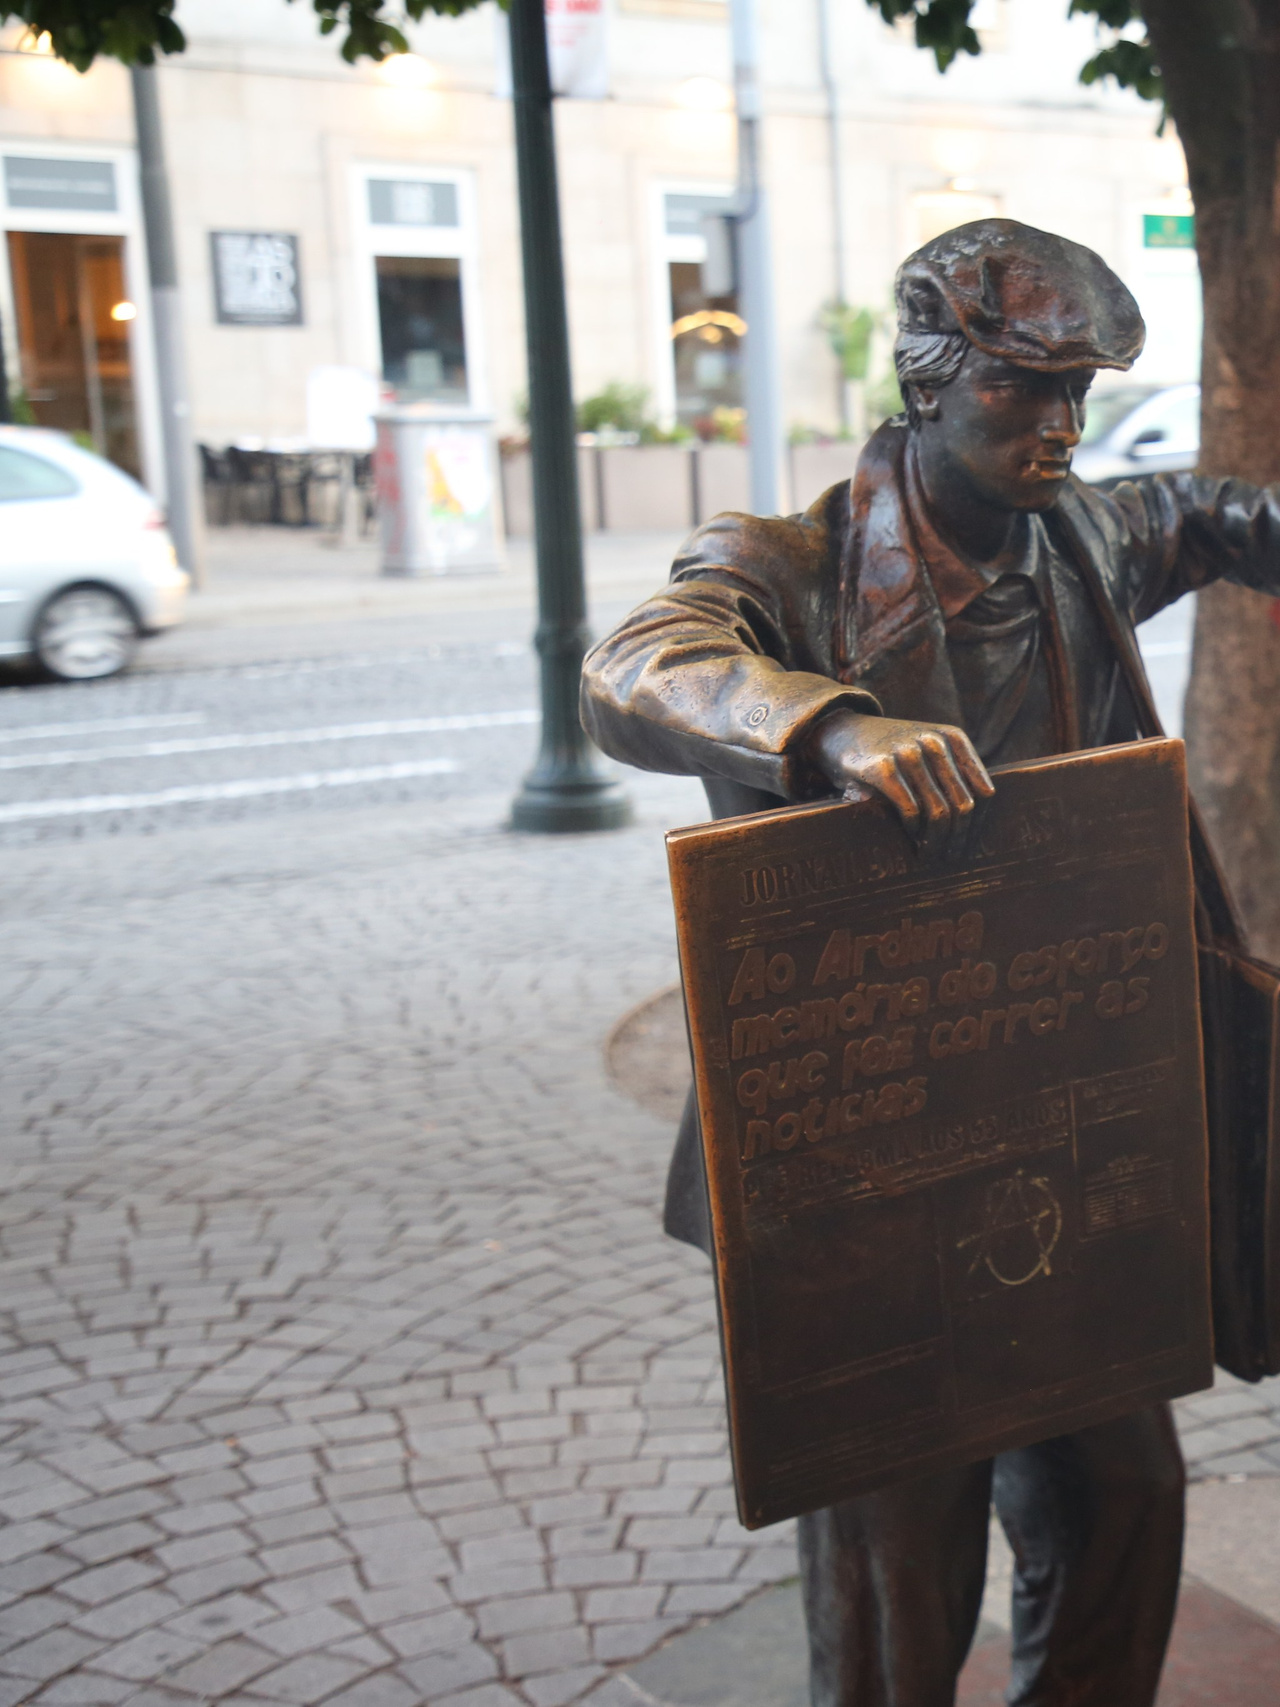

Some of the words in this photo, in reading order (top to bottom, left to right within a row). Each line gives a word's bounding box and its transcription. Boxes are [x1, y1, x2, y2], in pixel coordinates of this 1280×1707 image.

[727, 947, 797, 1006] Ao
[812, 910, 984, 986] Ardina
[732, 976, 930, 1060] memória
[938, 958, 997, 1007] do
[1008, 921, 1169, 991] esforço
[737, 1050, 830, 1115] que
[842, 1026, 917, 1090] faz
[929, 990, 1084, 1060] correr
[1094, 976, 1151, 1020] as
